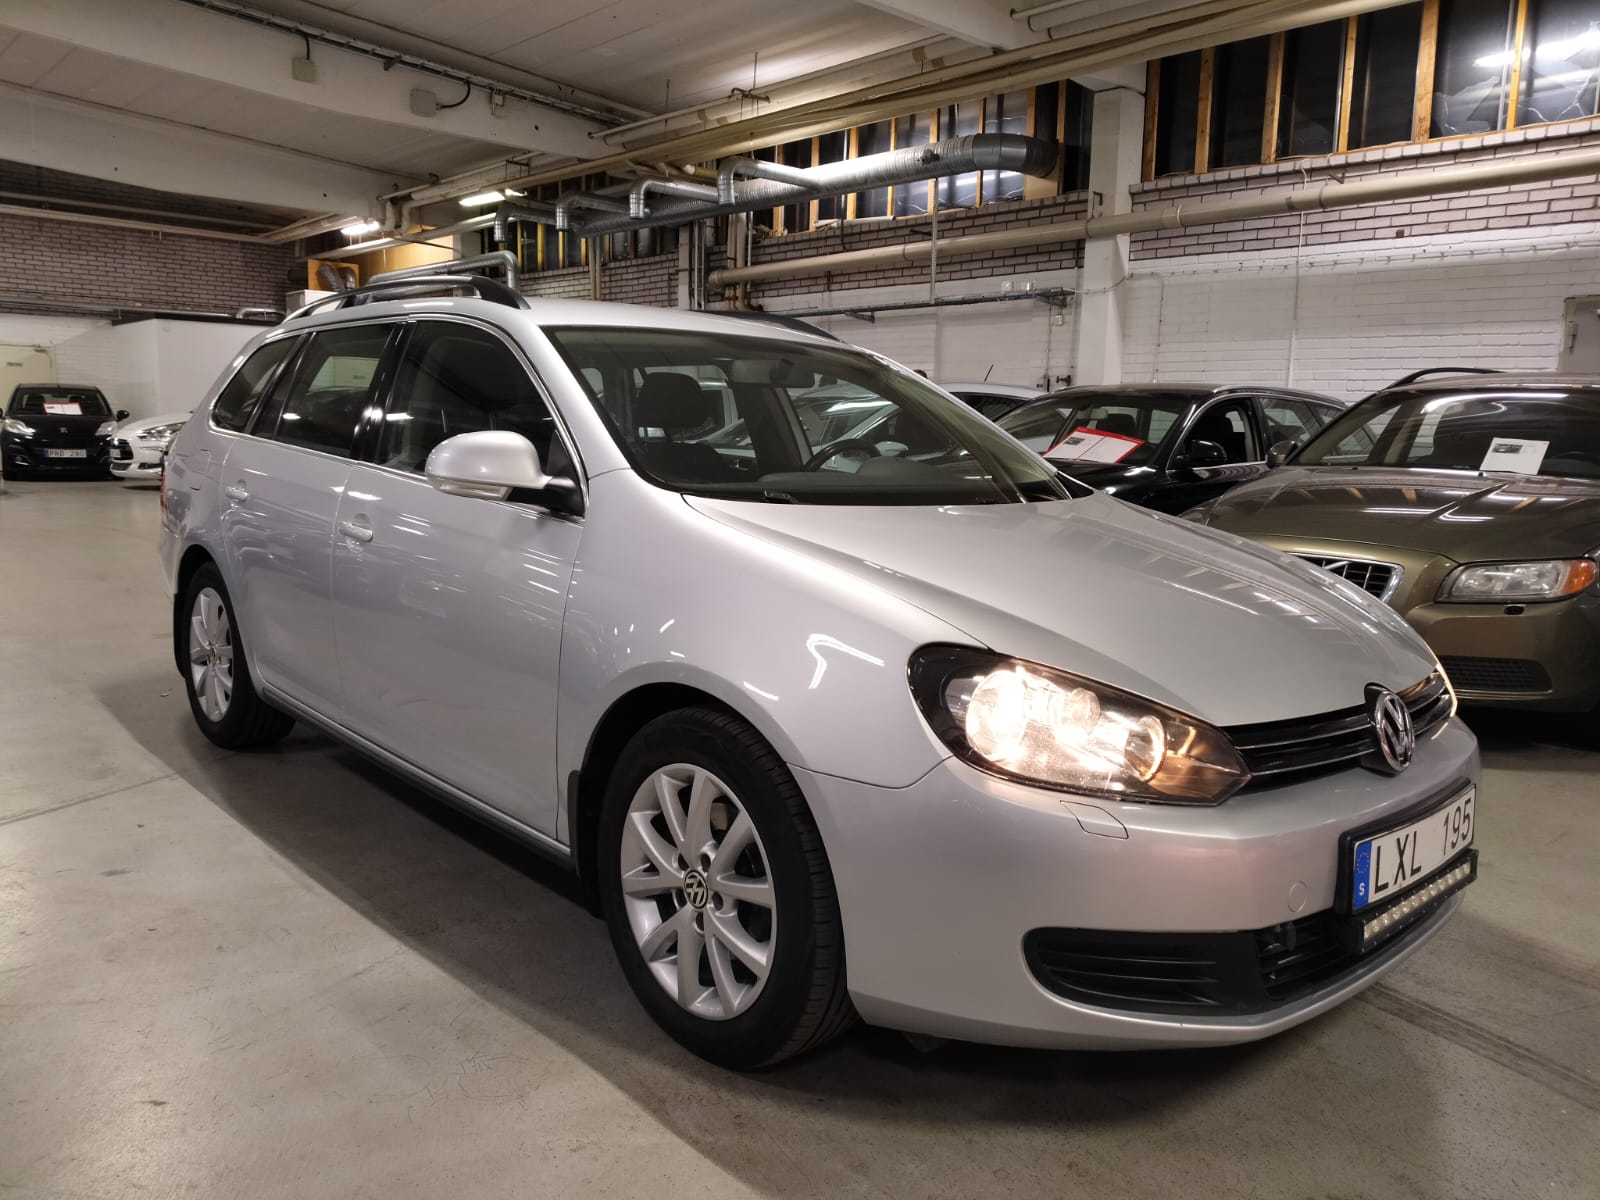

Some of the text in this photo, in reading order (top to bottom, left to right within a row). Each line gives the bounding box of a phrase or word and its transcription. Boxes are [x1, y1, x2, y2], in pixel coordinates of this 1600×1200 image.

[1375, 797, 1471, 894] LXL 195
[1359, 882, 1365, 896] S
